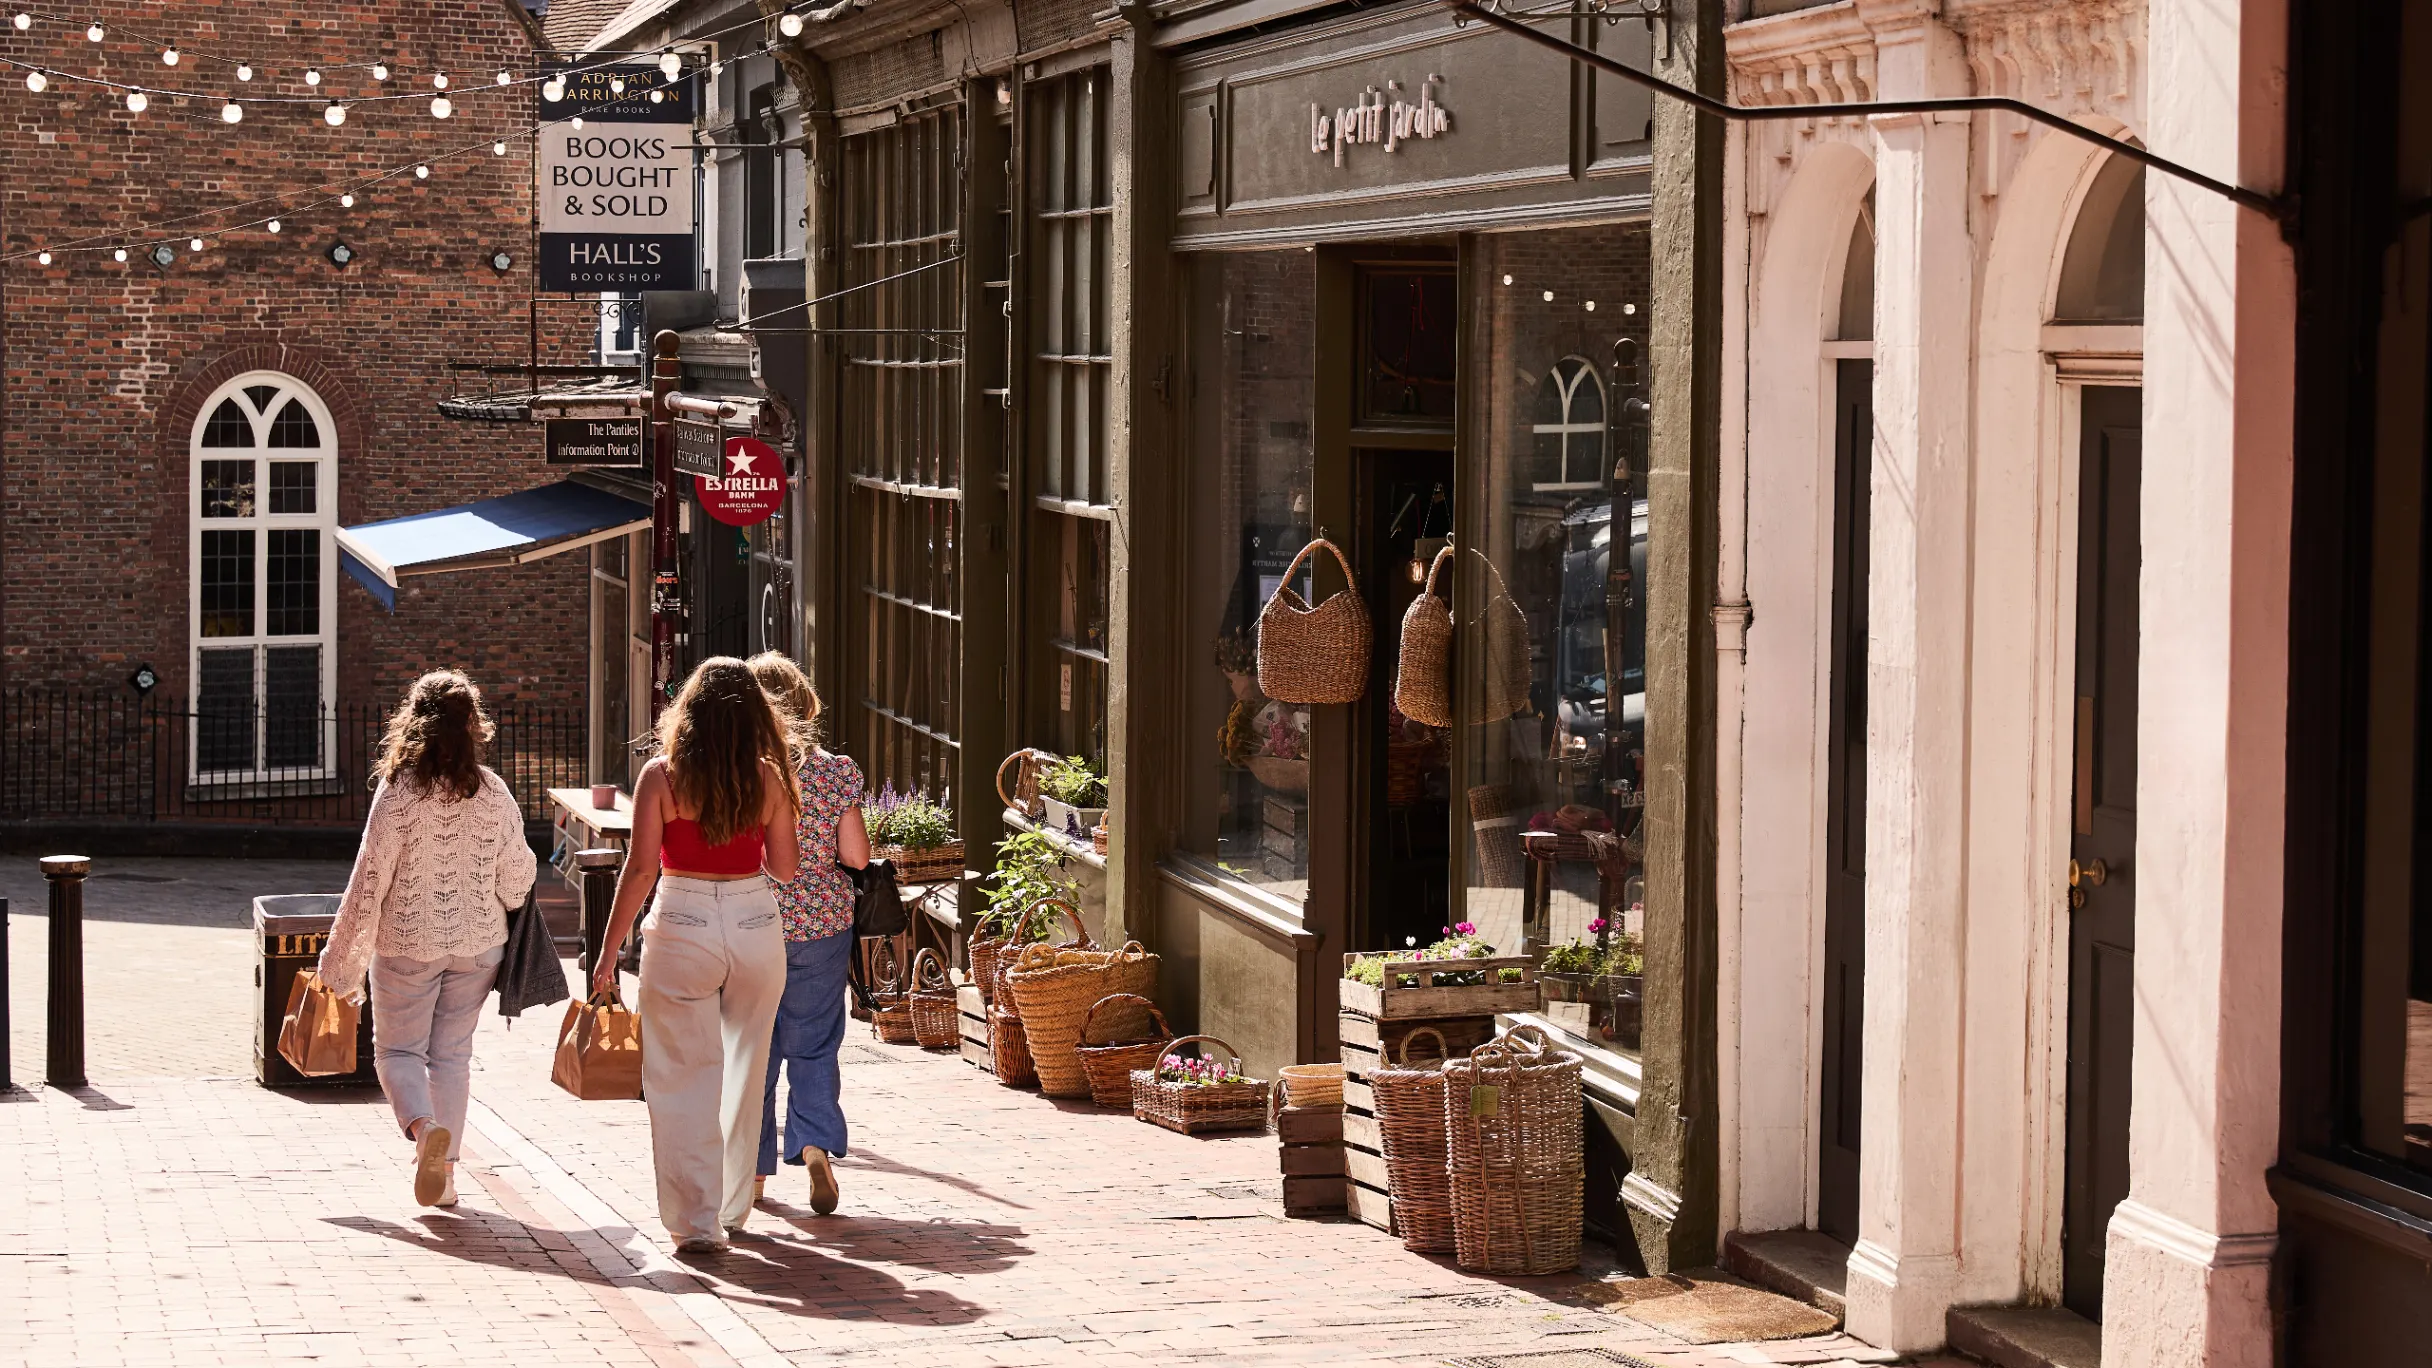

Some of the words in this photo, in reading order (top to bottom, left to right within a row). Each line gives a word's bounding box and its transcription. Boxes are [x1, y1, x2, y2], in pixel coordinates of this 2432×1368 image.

[616, 106, 651, 114] BOOKS
[1311, 102, 1330, 154] le
[1334, 84, 1384, 168] petit
[1384, 72, 1447, 153] jardin
[566, 137, 666, 160] BOOKS
[553, 165, 679, 188] BOUGHT
[564, 195, 584, 216] &
[591, 195, 668, 217] SOLD
[570, 242, 661, 265] HALL'S
[570, 272, 662, 282] BOOKSHOP
[588, 423, 604, 436] The
[606, 423, 639, 436] Pantiles
[557, 443, 606, 456] Information
[607, 443, 630, 456] Point
[705, 477, 779, 491] ESTRELLA
[728, 491, 755, 499] DAMM
